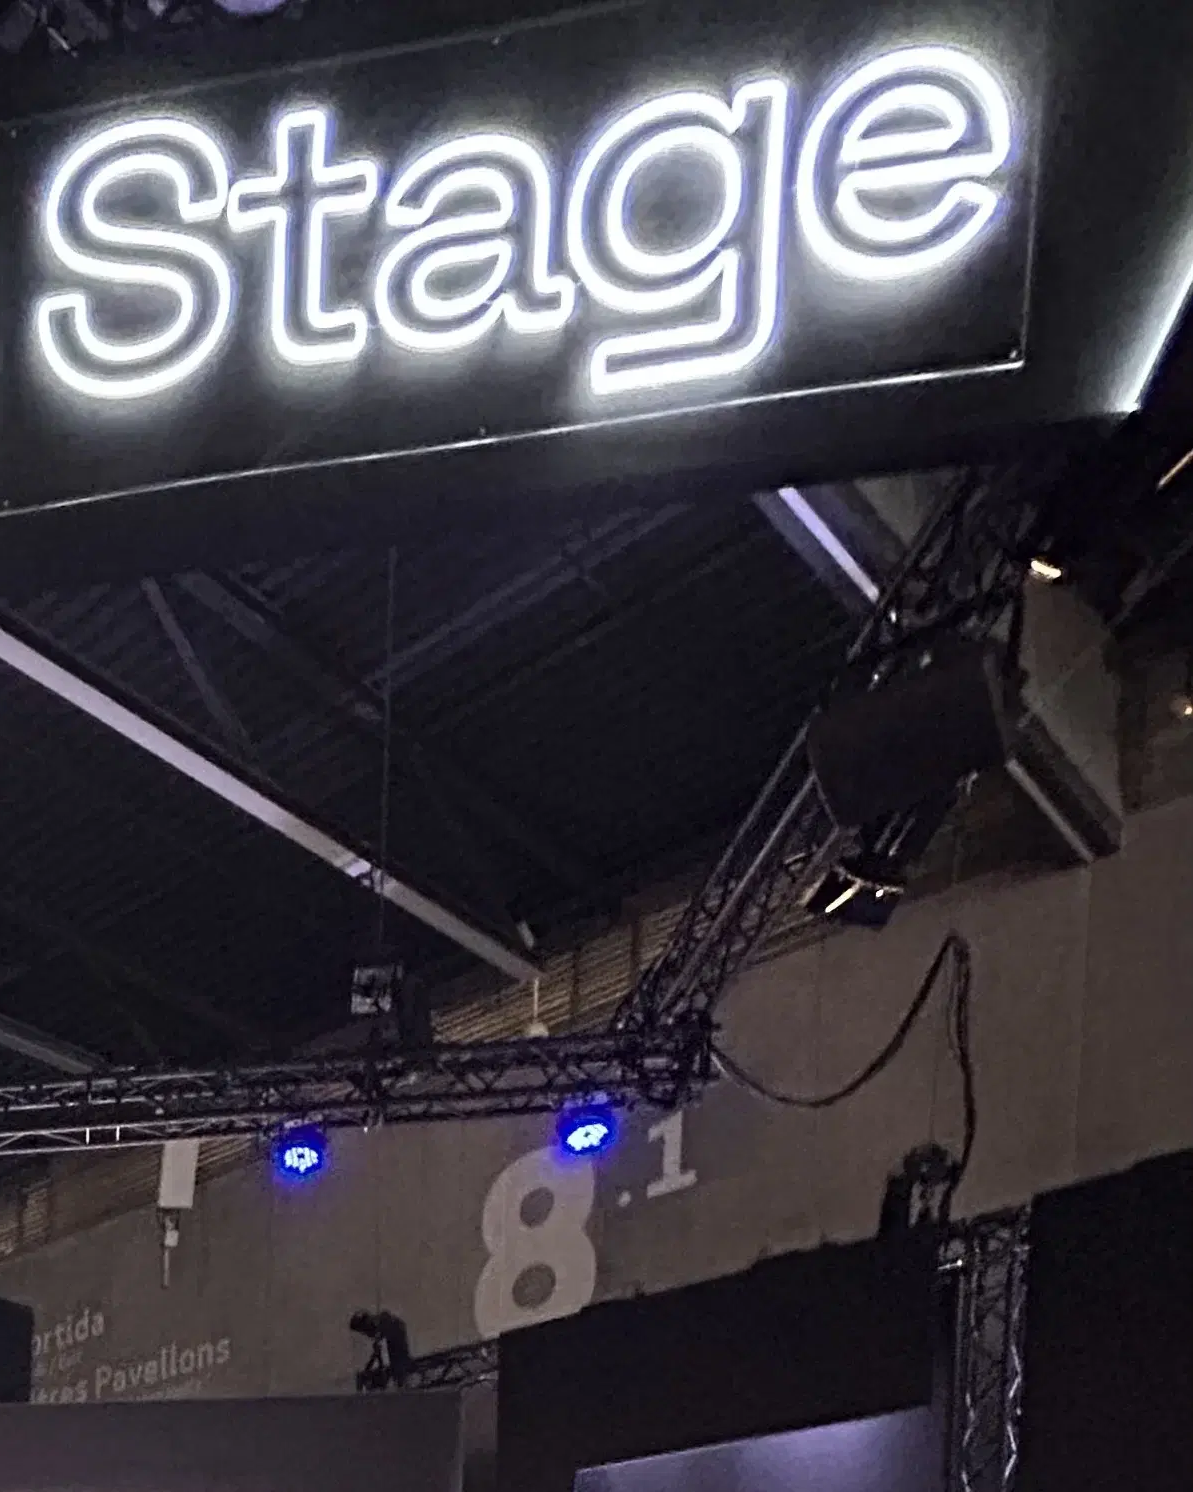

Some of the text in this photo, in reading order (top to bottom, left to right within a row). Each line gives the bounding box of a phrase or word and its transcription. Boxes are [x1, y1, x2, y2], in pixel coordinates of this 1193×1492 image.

[36, 44, 1012, 396] Stage
[474, 1110, 698, 1340] 8.1
[30, 1307, 105, 1357] ortida
[94, 1336, 232, 1399] Pavellons
